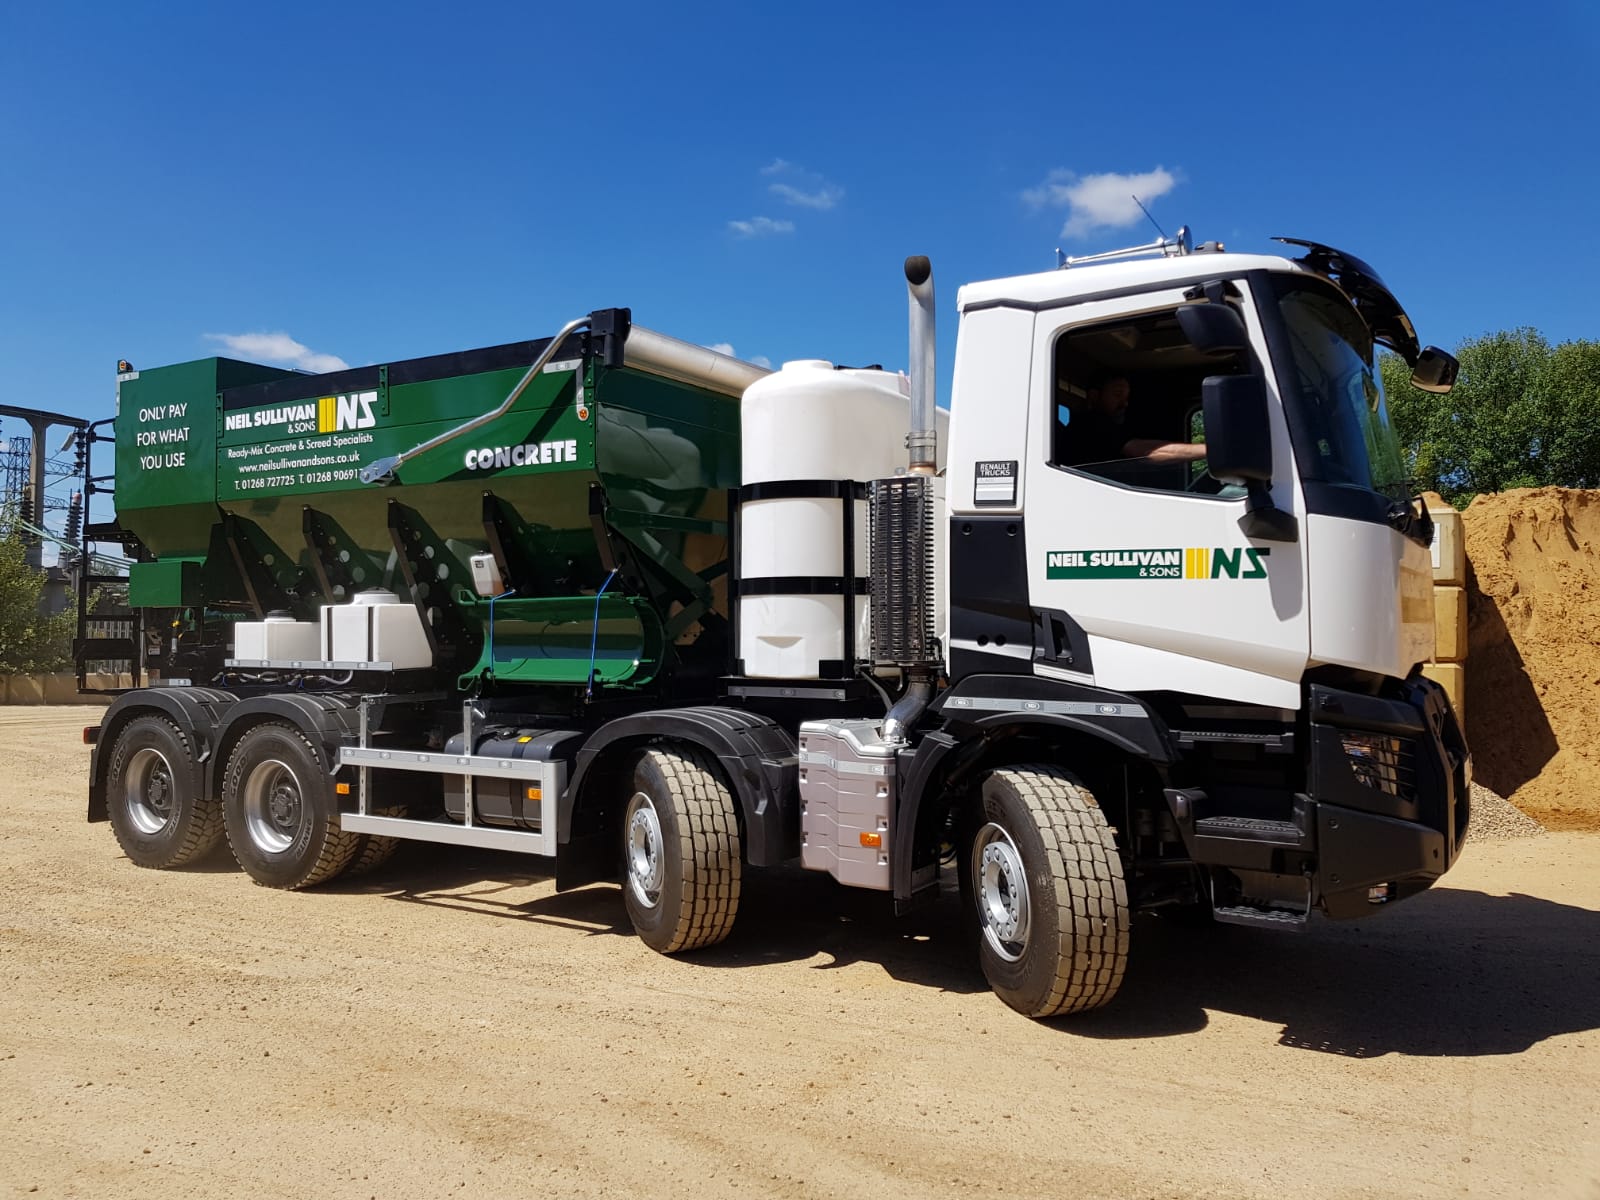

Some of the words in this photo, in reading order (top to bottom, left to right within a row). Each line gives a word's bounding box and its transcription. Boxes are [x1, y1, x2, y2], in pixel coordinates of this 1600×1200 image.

[139, 405, 166, 422] ONLY
[168, 403, 188, 418] PAY
[225, 413, 252, 431] NEIL
[254, 403, 316, 426] SULLIVAN
[287, 424, 294, 434] &
[294, 420, 316, 433] SONS
[137, 431, 157, 447] FOR
[158, 427, 190, 443] WHAT
[227, 445, 264, 460] Ready-Mix
[264, 440, 297, 455] Concrete
[298, 440, 305, 450] &
[306, 436, 332, 449] Screed
[333, 433, 374, 447] Specialists
[140, 454, 163, 470] YOU
[165, 452, 186, 468] USE
[238, 450, 360, 474] www.neilsullivanandsons.co.uk
[465, 439, 577, 471] CONCRETE
[980, 462, 1011, 471] RENAULT
[980, 469, 1011, 477] TRUCKS
[242, 477, 265, 490] 01268
[267, 475, 295, 488] 727725
[306, 470, 332, 484] 01268
[334, 468, 364, 481] 90691
[1048, 552, 1087, 568] NEIL
[1089, 550, 1180, 568] SULLIVAN
[1139, 568, 1148, 577] &
[1149, 567, 1180, 577] SONS
